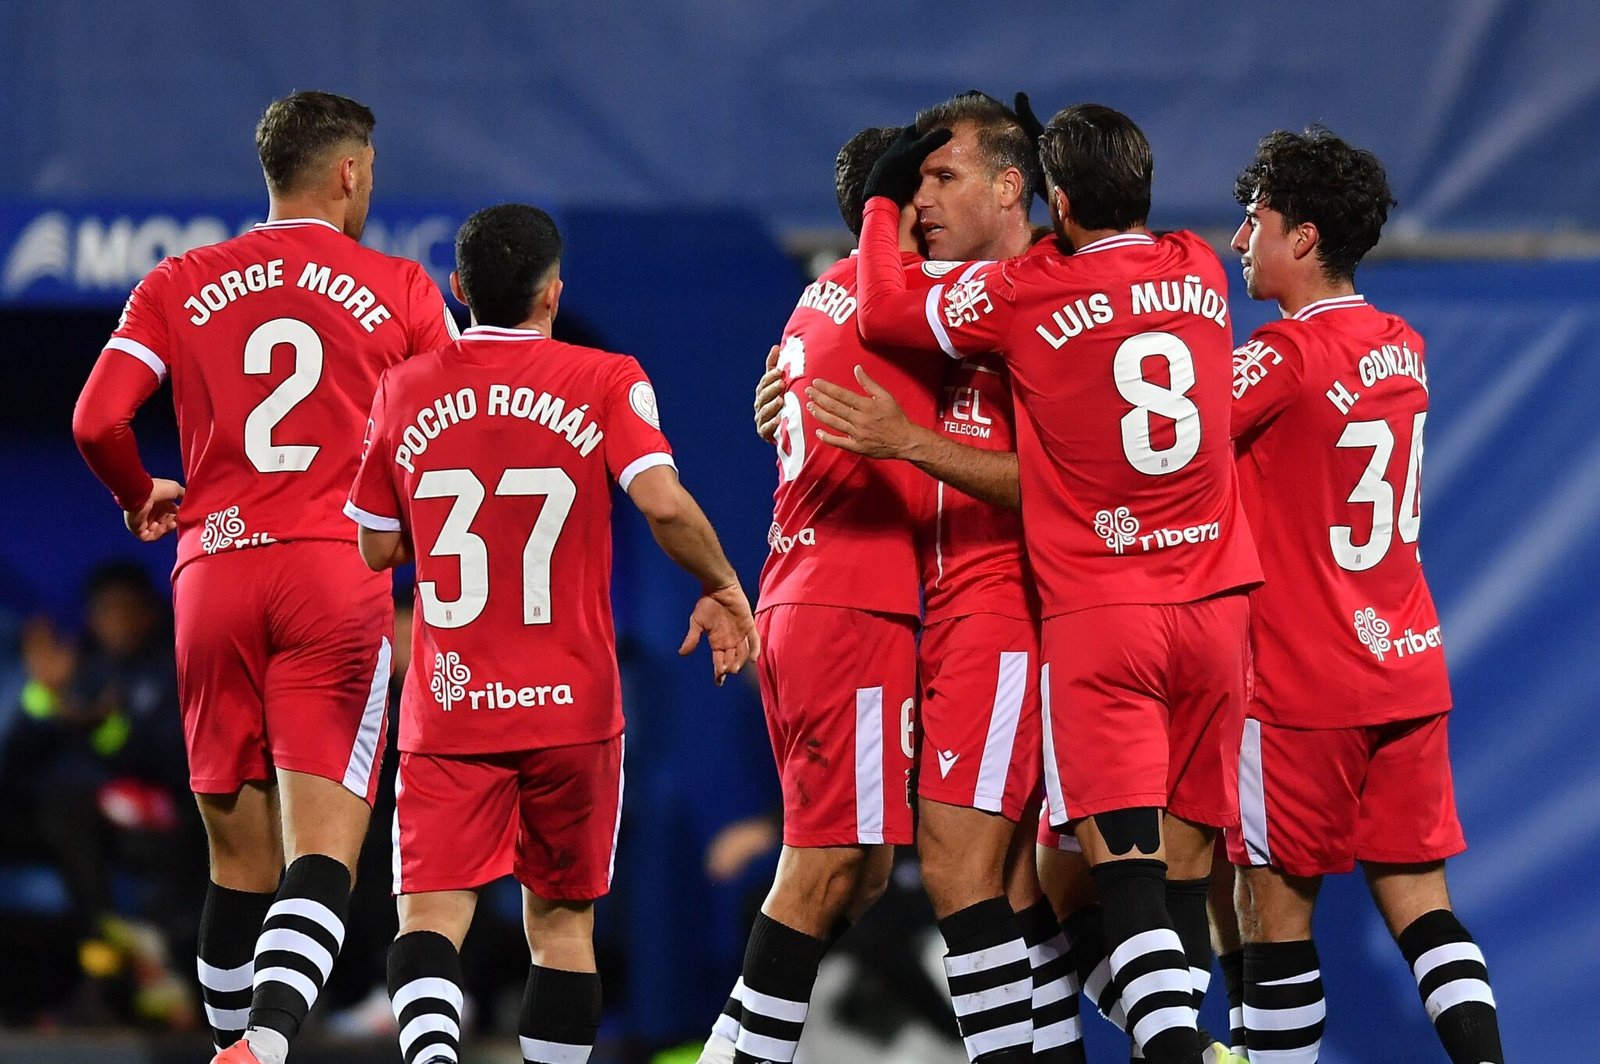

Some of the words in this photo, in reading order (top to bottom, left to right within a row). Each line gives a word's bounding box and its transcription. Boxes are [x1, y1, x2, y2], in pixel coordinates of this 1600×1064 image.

[183, 259, 284, 327] JORGE
[297, 262, 392, 333] MORE
[1036, 293, 1114, 350] LUIS
[1130, 275, 1228, 328] MUÑOZ
[243, 317, 323, 473] 2
[395, 387, 477, 474] POCHO
[487, 384, 604, 458] ROMÁN
[944, 421, 991, 439] TELECOM
[1113, 332, 1201, 476] 8
[413, 467, 577, 628] 37
[1139, 521, 1220, 551] ribera
[468, 682, 574, 710] ribera
